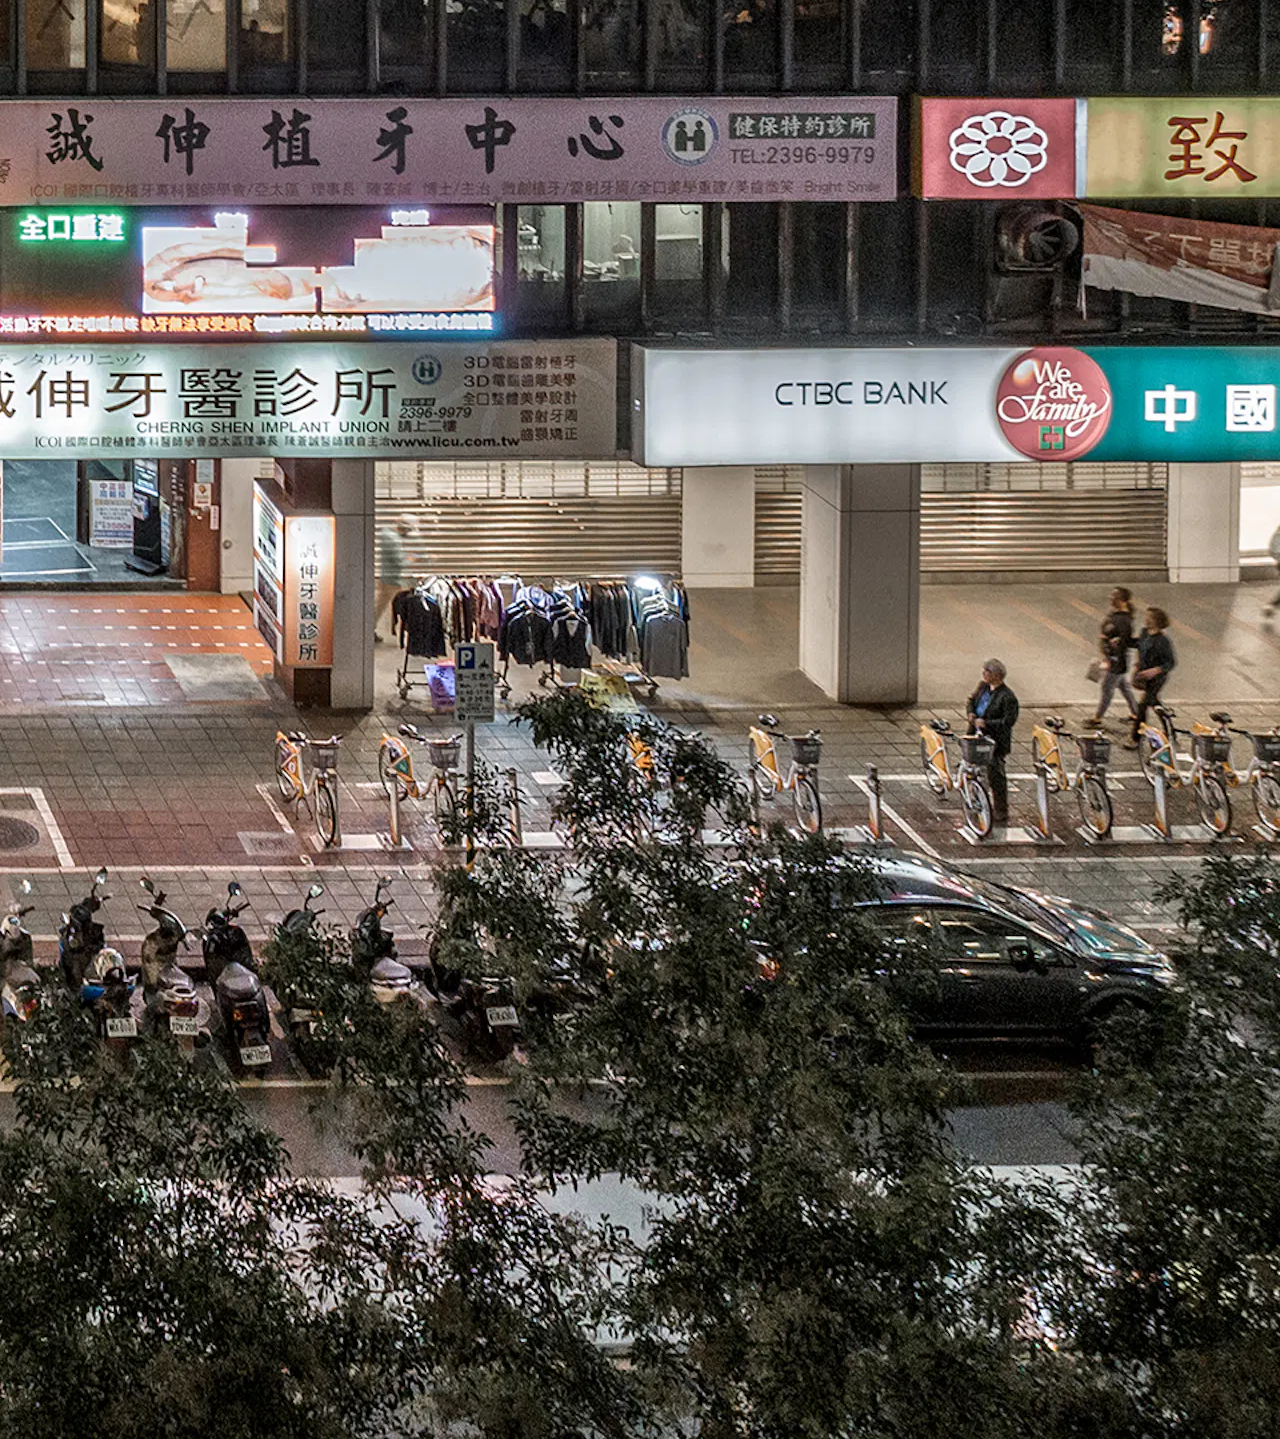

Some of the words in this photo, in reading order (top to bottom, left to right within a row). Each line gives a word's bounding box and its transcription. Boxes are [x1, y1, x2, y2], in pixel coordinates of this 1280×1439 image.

[733, 115, 872, 138] 健保特約診所
[44, 107, 625, 176] 誠伸植牙中心
[1164, 111, 1258, 183] 致
[730, 146, 876, 164] TEL:2396-9979
[1033, 360, 1072, 384] We
[775, 382, 854, 406] CTBC
[863, 381, 950, 405] BANK
[399, 406, 472, 420] 2396-9979
[1144, 384, 1278, 433] 中國
[136, 420, 204, 434] CHERNG
[210, 420, 255, 434] SHEN
[260, 420, 331, 434] IMPLANT
[338, 420, 391, 434] UNION
[34, 435, 63, 449] ICOI
[389, 436, 521, 448] www.licu.com.tw
